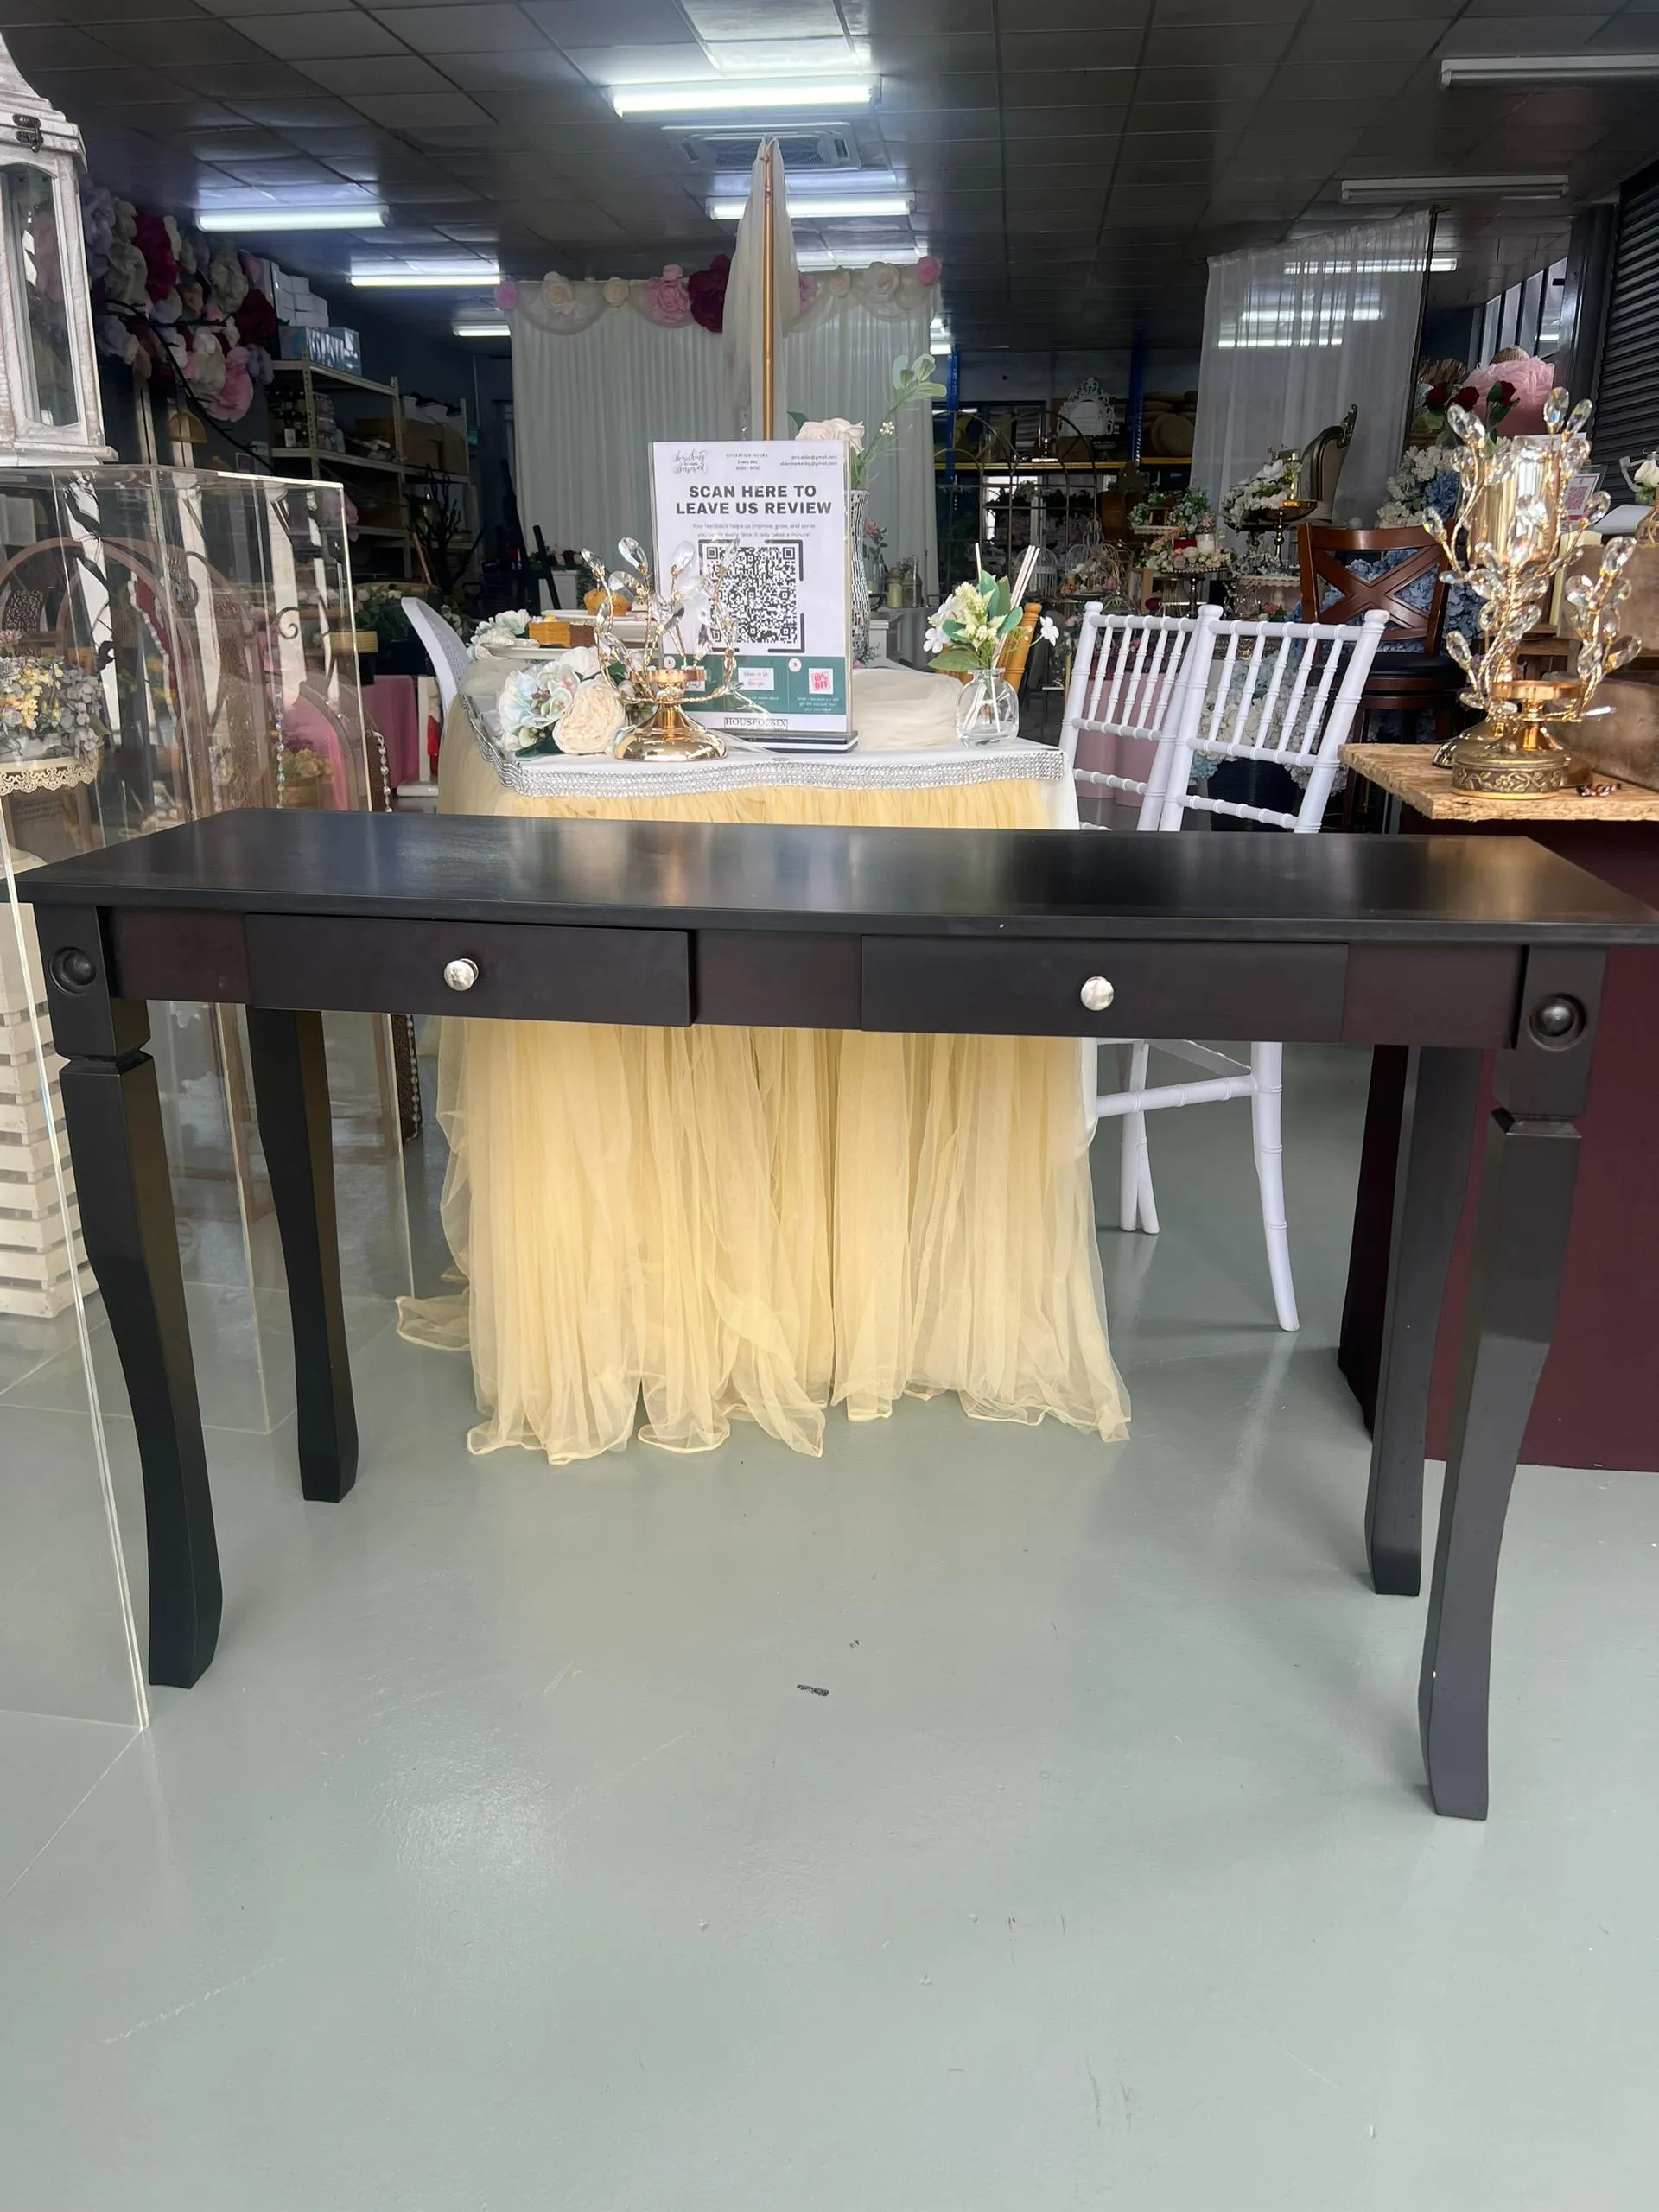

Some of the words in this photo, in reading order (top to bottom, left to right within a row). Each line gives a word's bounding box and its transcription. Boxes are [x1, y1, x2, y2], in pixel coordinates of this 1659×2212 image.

[689, 486, 735, 498] SCAN
[741, 486, 787, 498] HERE
[794, 485, 817, 498] TO
[676, 502, 729, 514] LEAVE
[736, 502, 758, 514] US
[765, 502, 832, 514] REVIEW
